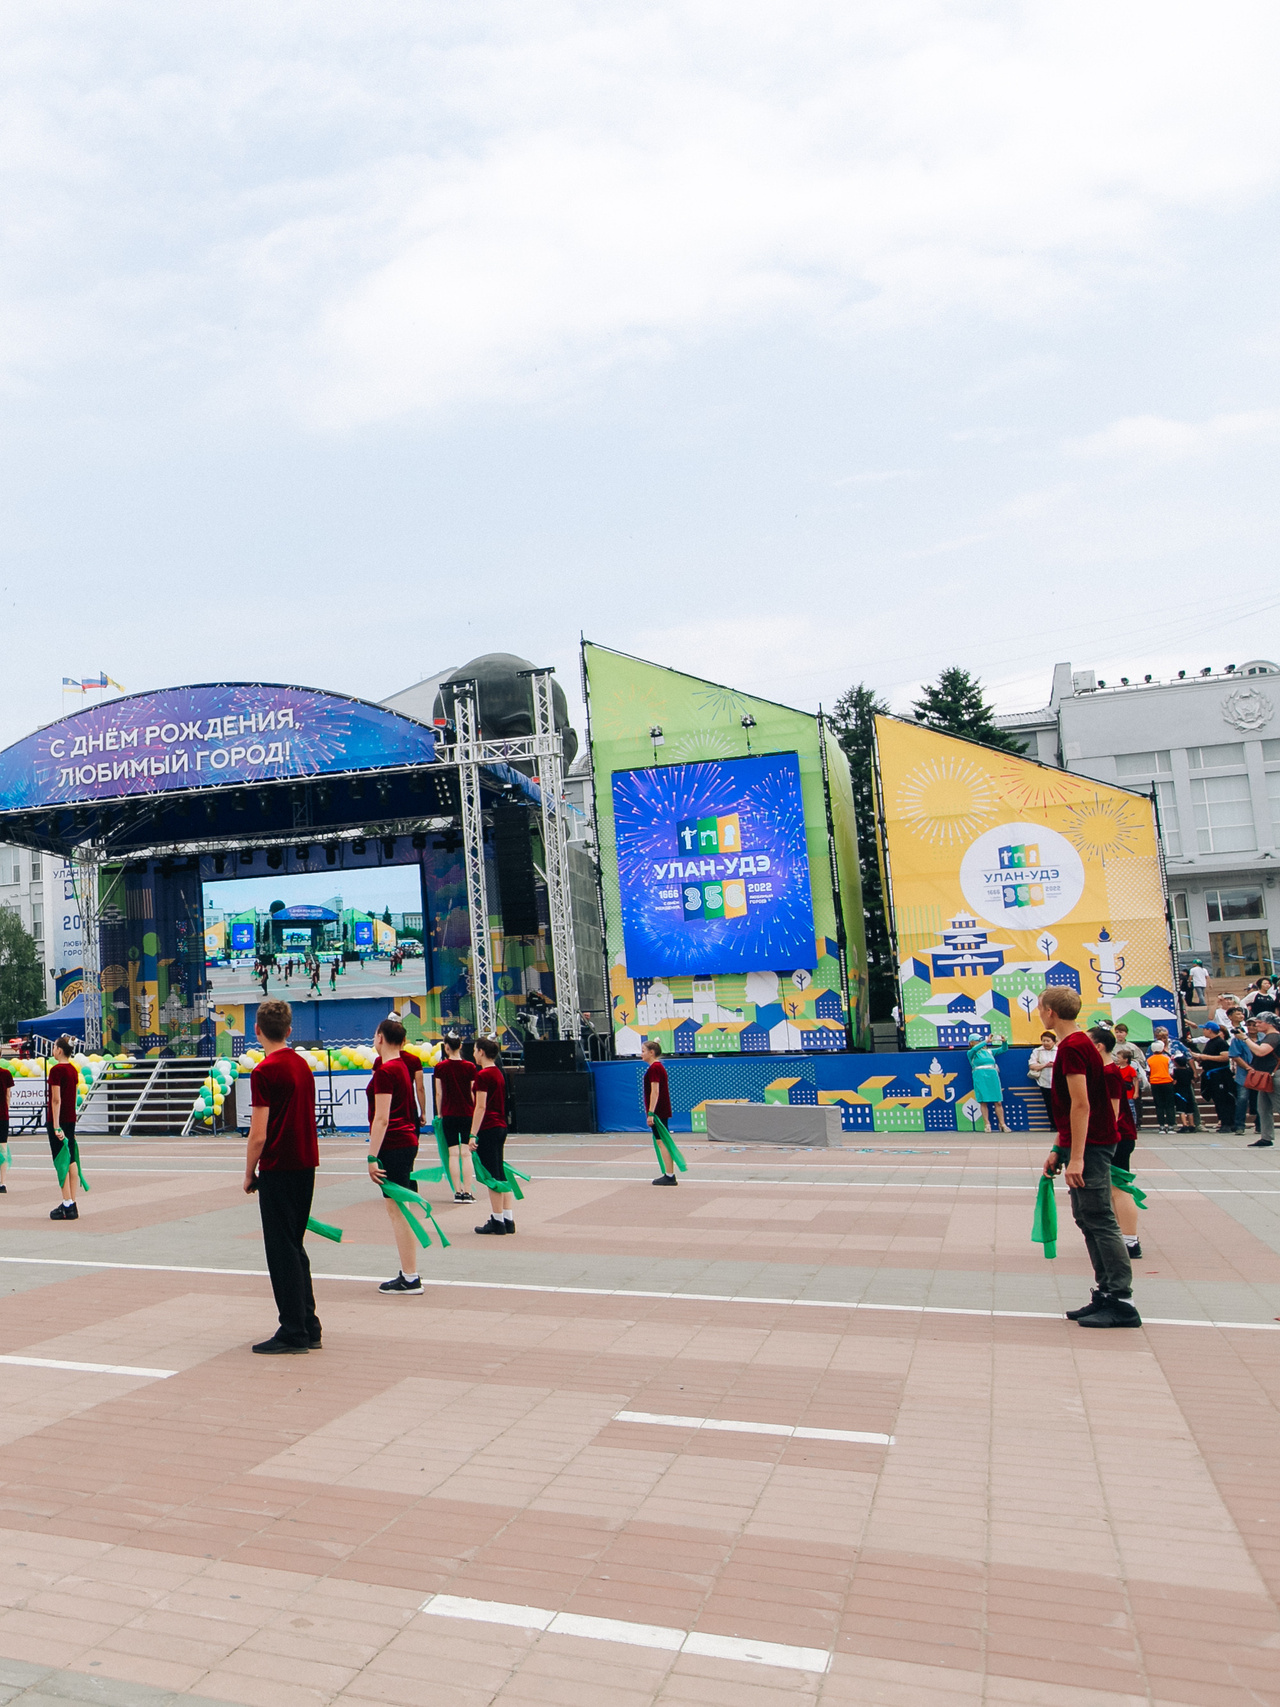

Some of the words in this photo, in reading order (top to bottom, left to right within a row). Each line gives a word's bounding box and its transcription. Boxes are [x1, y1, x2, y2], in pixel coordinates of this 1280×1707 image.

[50, 739, 65, 758] С
[70, 728, 138, 759] ДНЁМ
[145, 708, 300, 746] РОЖДЕНИЯ,
[58, 751, 188, 788] ЛЮБИМЫЙ
[196, 741, 291, 771] ГОРОД!
[653, 855, 771, 880] УЛАН-УДЭ
[984, 869, 1060, 883] УЛАН-УДЭ
[659, 889, 679, 899] 1666
[684, 884, 746, 911] 356
[747, 882, 773, 893] 2022
